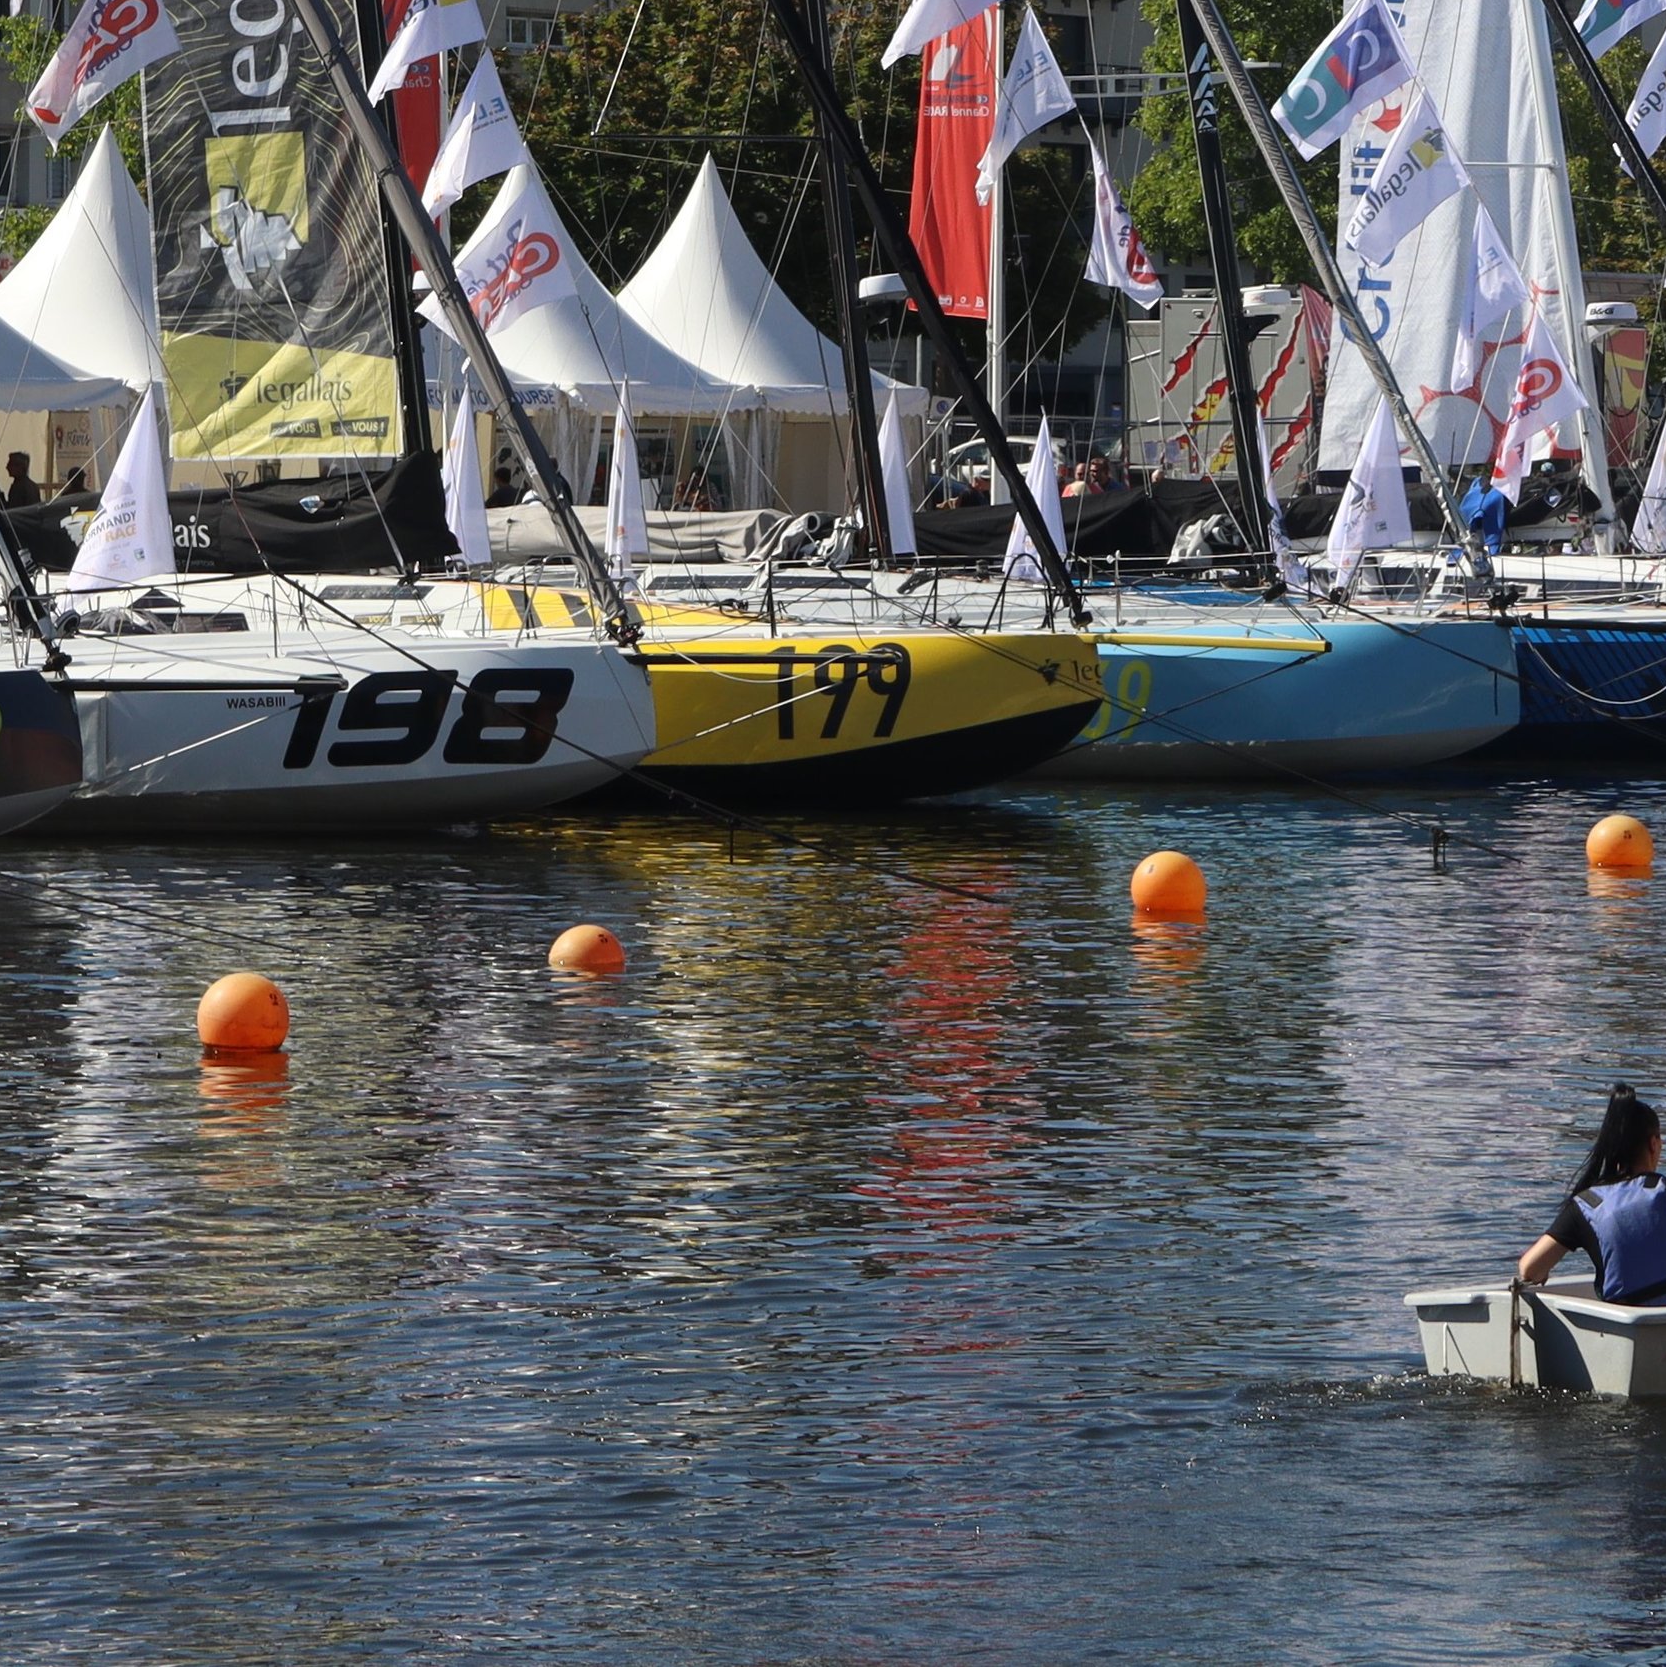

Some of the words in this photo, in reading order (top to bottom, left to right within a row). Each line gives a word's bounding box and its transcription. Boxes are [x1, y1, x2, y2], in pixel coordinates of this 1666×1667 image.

[256, 371, 352, 411] legallais
[518, 389, 556, 405] OURSE
[289, 422, 316, 434] VOUS
[351, 421, 378, 433] VOUS
[84, 510, 137, 544] ORMANDY
[226, 696, 287, 709] WASABIII
[768, 641, 911, 740] 199
[283, 667, 575, 770] 198
